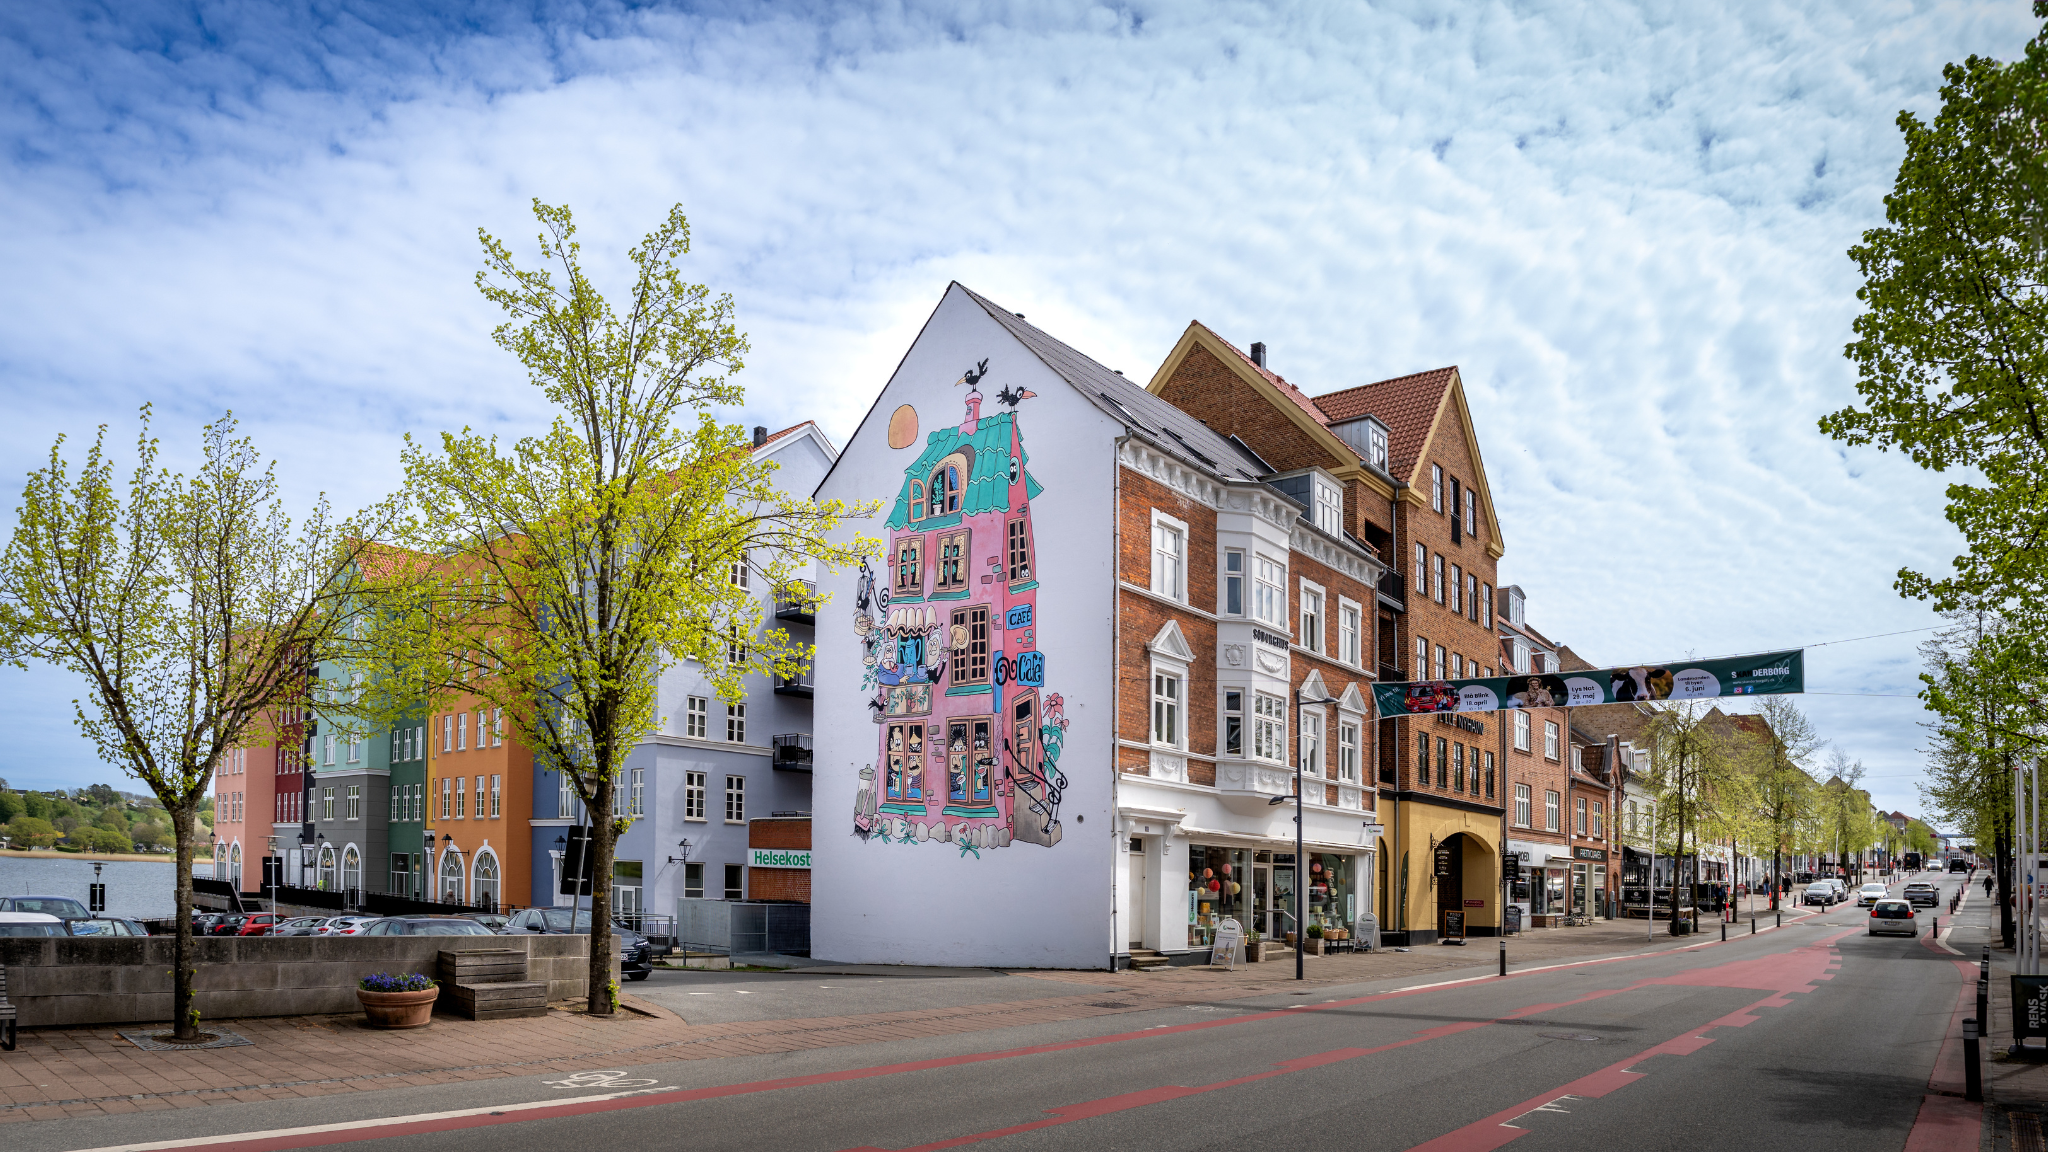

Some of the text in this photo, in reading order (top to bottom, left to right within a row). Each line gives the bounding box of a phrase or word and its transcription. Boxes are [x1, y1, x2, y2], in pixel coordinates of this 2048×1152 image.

[1009, 608, 1031, 626] CAFÉ
[1019, 653, 1042, 683] Café
[1731, 667, 1790, 679] SKANDERBORG
[1583, 692, 1595, 700] maj
[1692, 685, 1705, 693] juni
[1457, 714, 1484, 736] NYHAVN
[754, 850, 812, 867] Helsekost
[2028, 998, 2039, 1029] RENS
